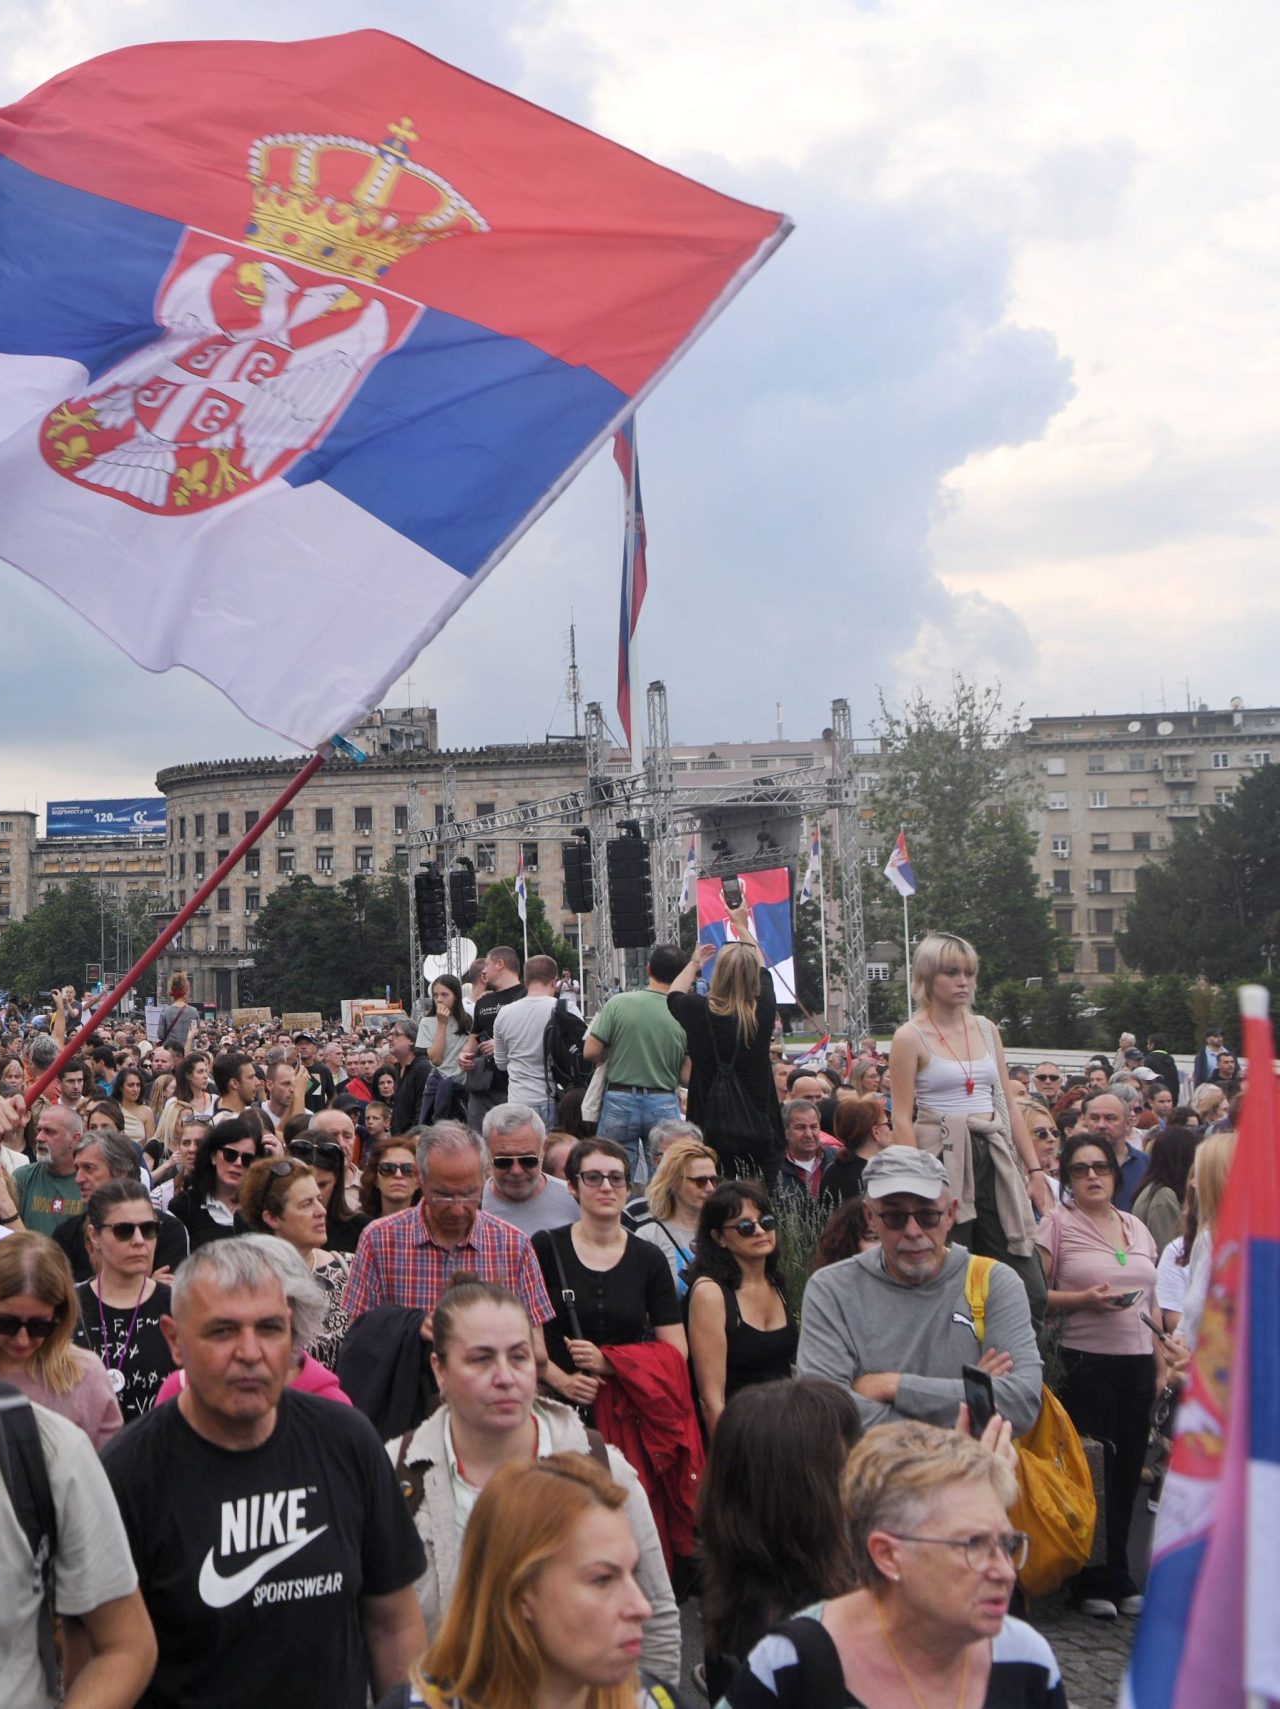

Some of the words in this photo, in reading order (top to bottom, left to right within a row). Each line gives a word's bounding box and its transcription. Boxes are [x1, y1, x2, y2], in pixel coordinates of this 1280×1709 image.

[95, 812, 113, 822] 120
[221, 1487, 308, 1557] NIKE
[253, 1572, 343, 1607] SPORTSWEAR
